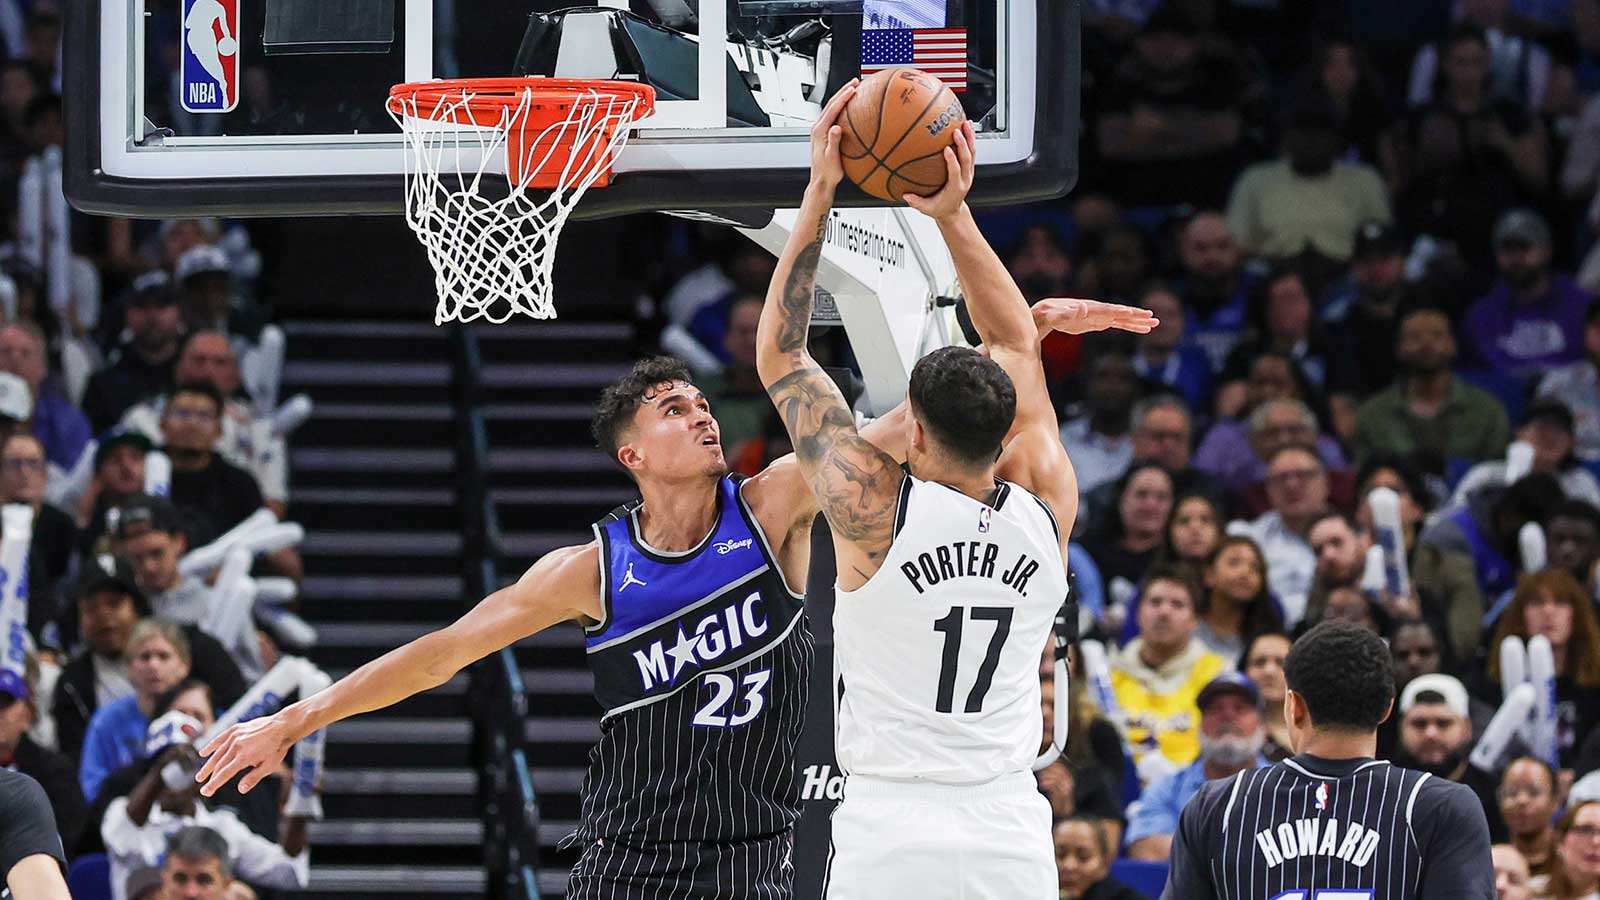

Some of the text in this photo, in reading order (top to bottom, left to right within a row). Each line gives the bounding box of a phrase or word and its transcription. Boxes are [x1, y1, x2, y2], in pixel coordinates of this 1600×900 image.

[189, 82, 217, 104] NBA
[712, 538, 753, 555] Disney
[900, 541, 1040, 598] PORTER JR.
[933, 605, 1015, 713] 17
[692, 669, 771, 728] 23
[1256, 817, 1380, 868] HOWARD
